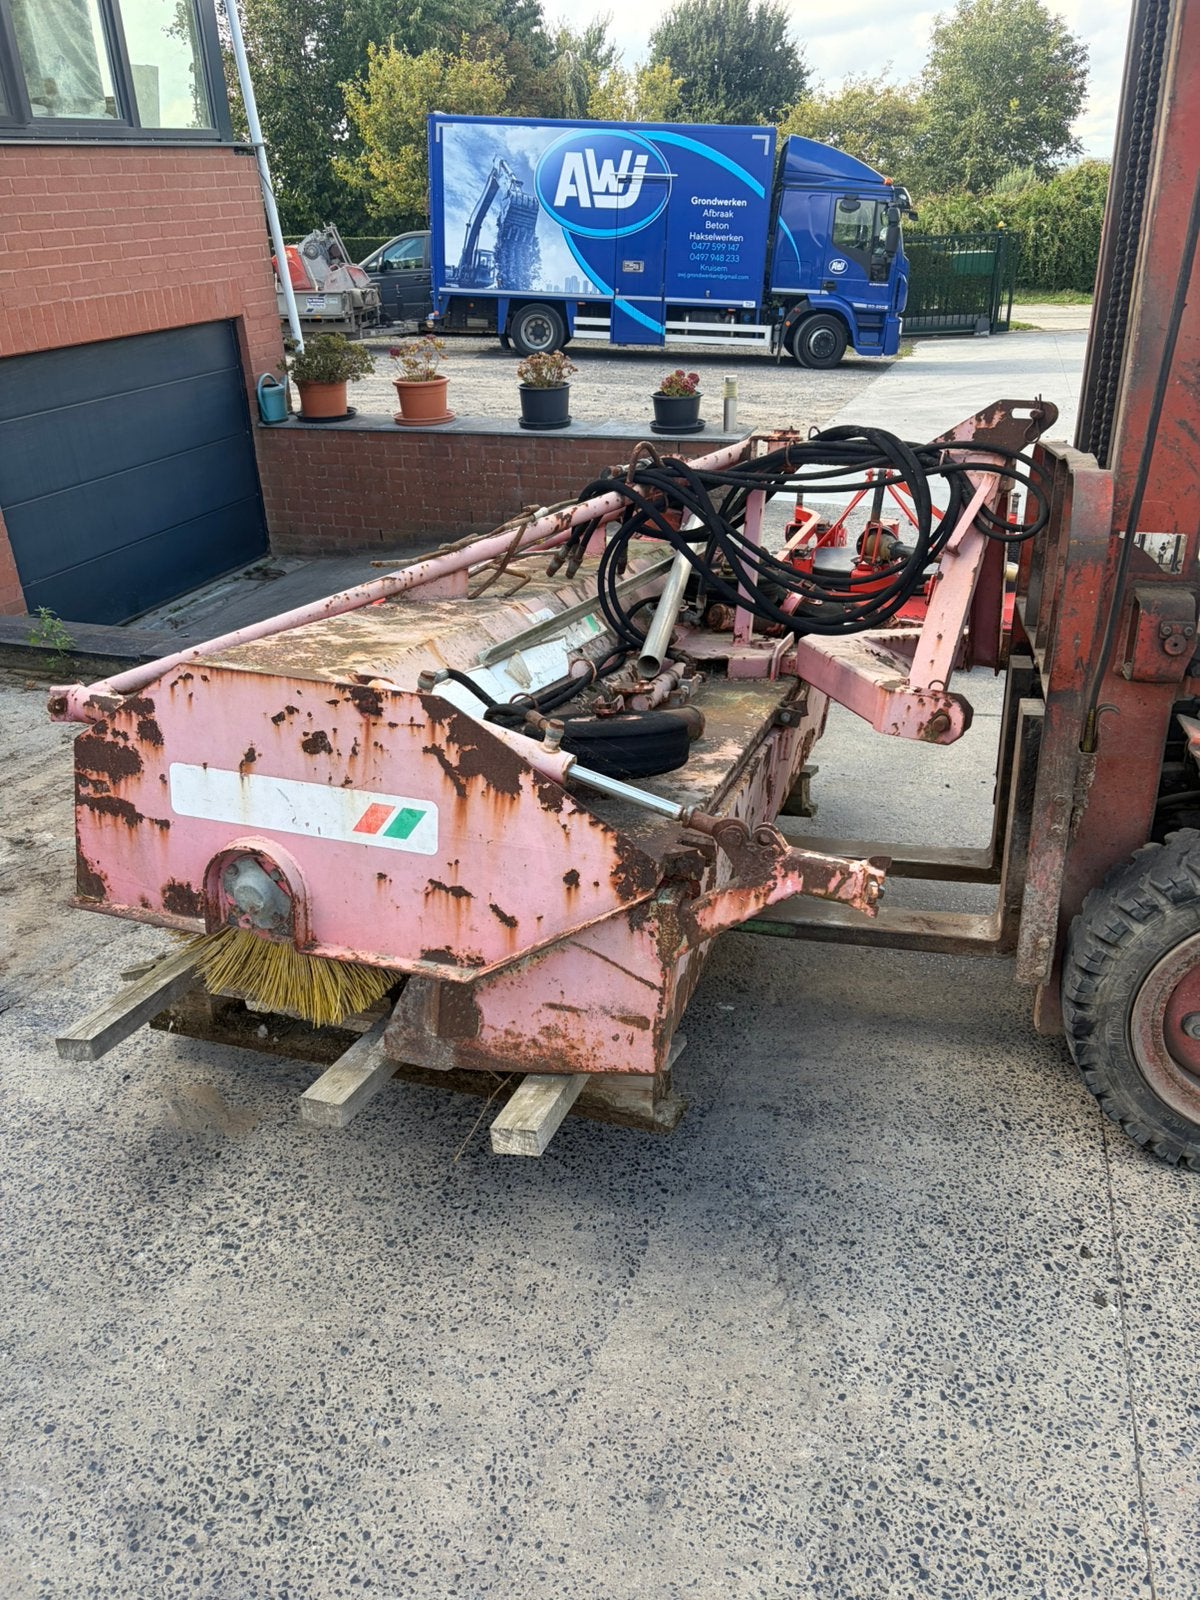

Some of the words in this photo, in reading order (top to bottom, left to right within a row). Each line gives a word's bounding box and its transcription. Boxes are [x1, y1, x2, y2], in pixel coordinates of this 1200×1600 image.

[554, 148, 649, 209] AWJ
[691, 196, 748, 207] Grondwerken
[702, 209, 734, 218] Afbraak
[705, 220, 730, 230] Beton
[689, 232, 744, 242] Hakselwerken
[691, 242, 710, 250] 0477
[711, 243, 726, 251] 599
[728, 243, 740, 251] 147
[689, 252, 709, 261] 0497
[710, 254, 725, 262] 948
[725, 255, 740, 263] 233
[700, 264, 728, 272] Kruisem
